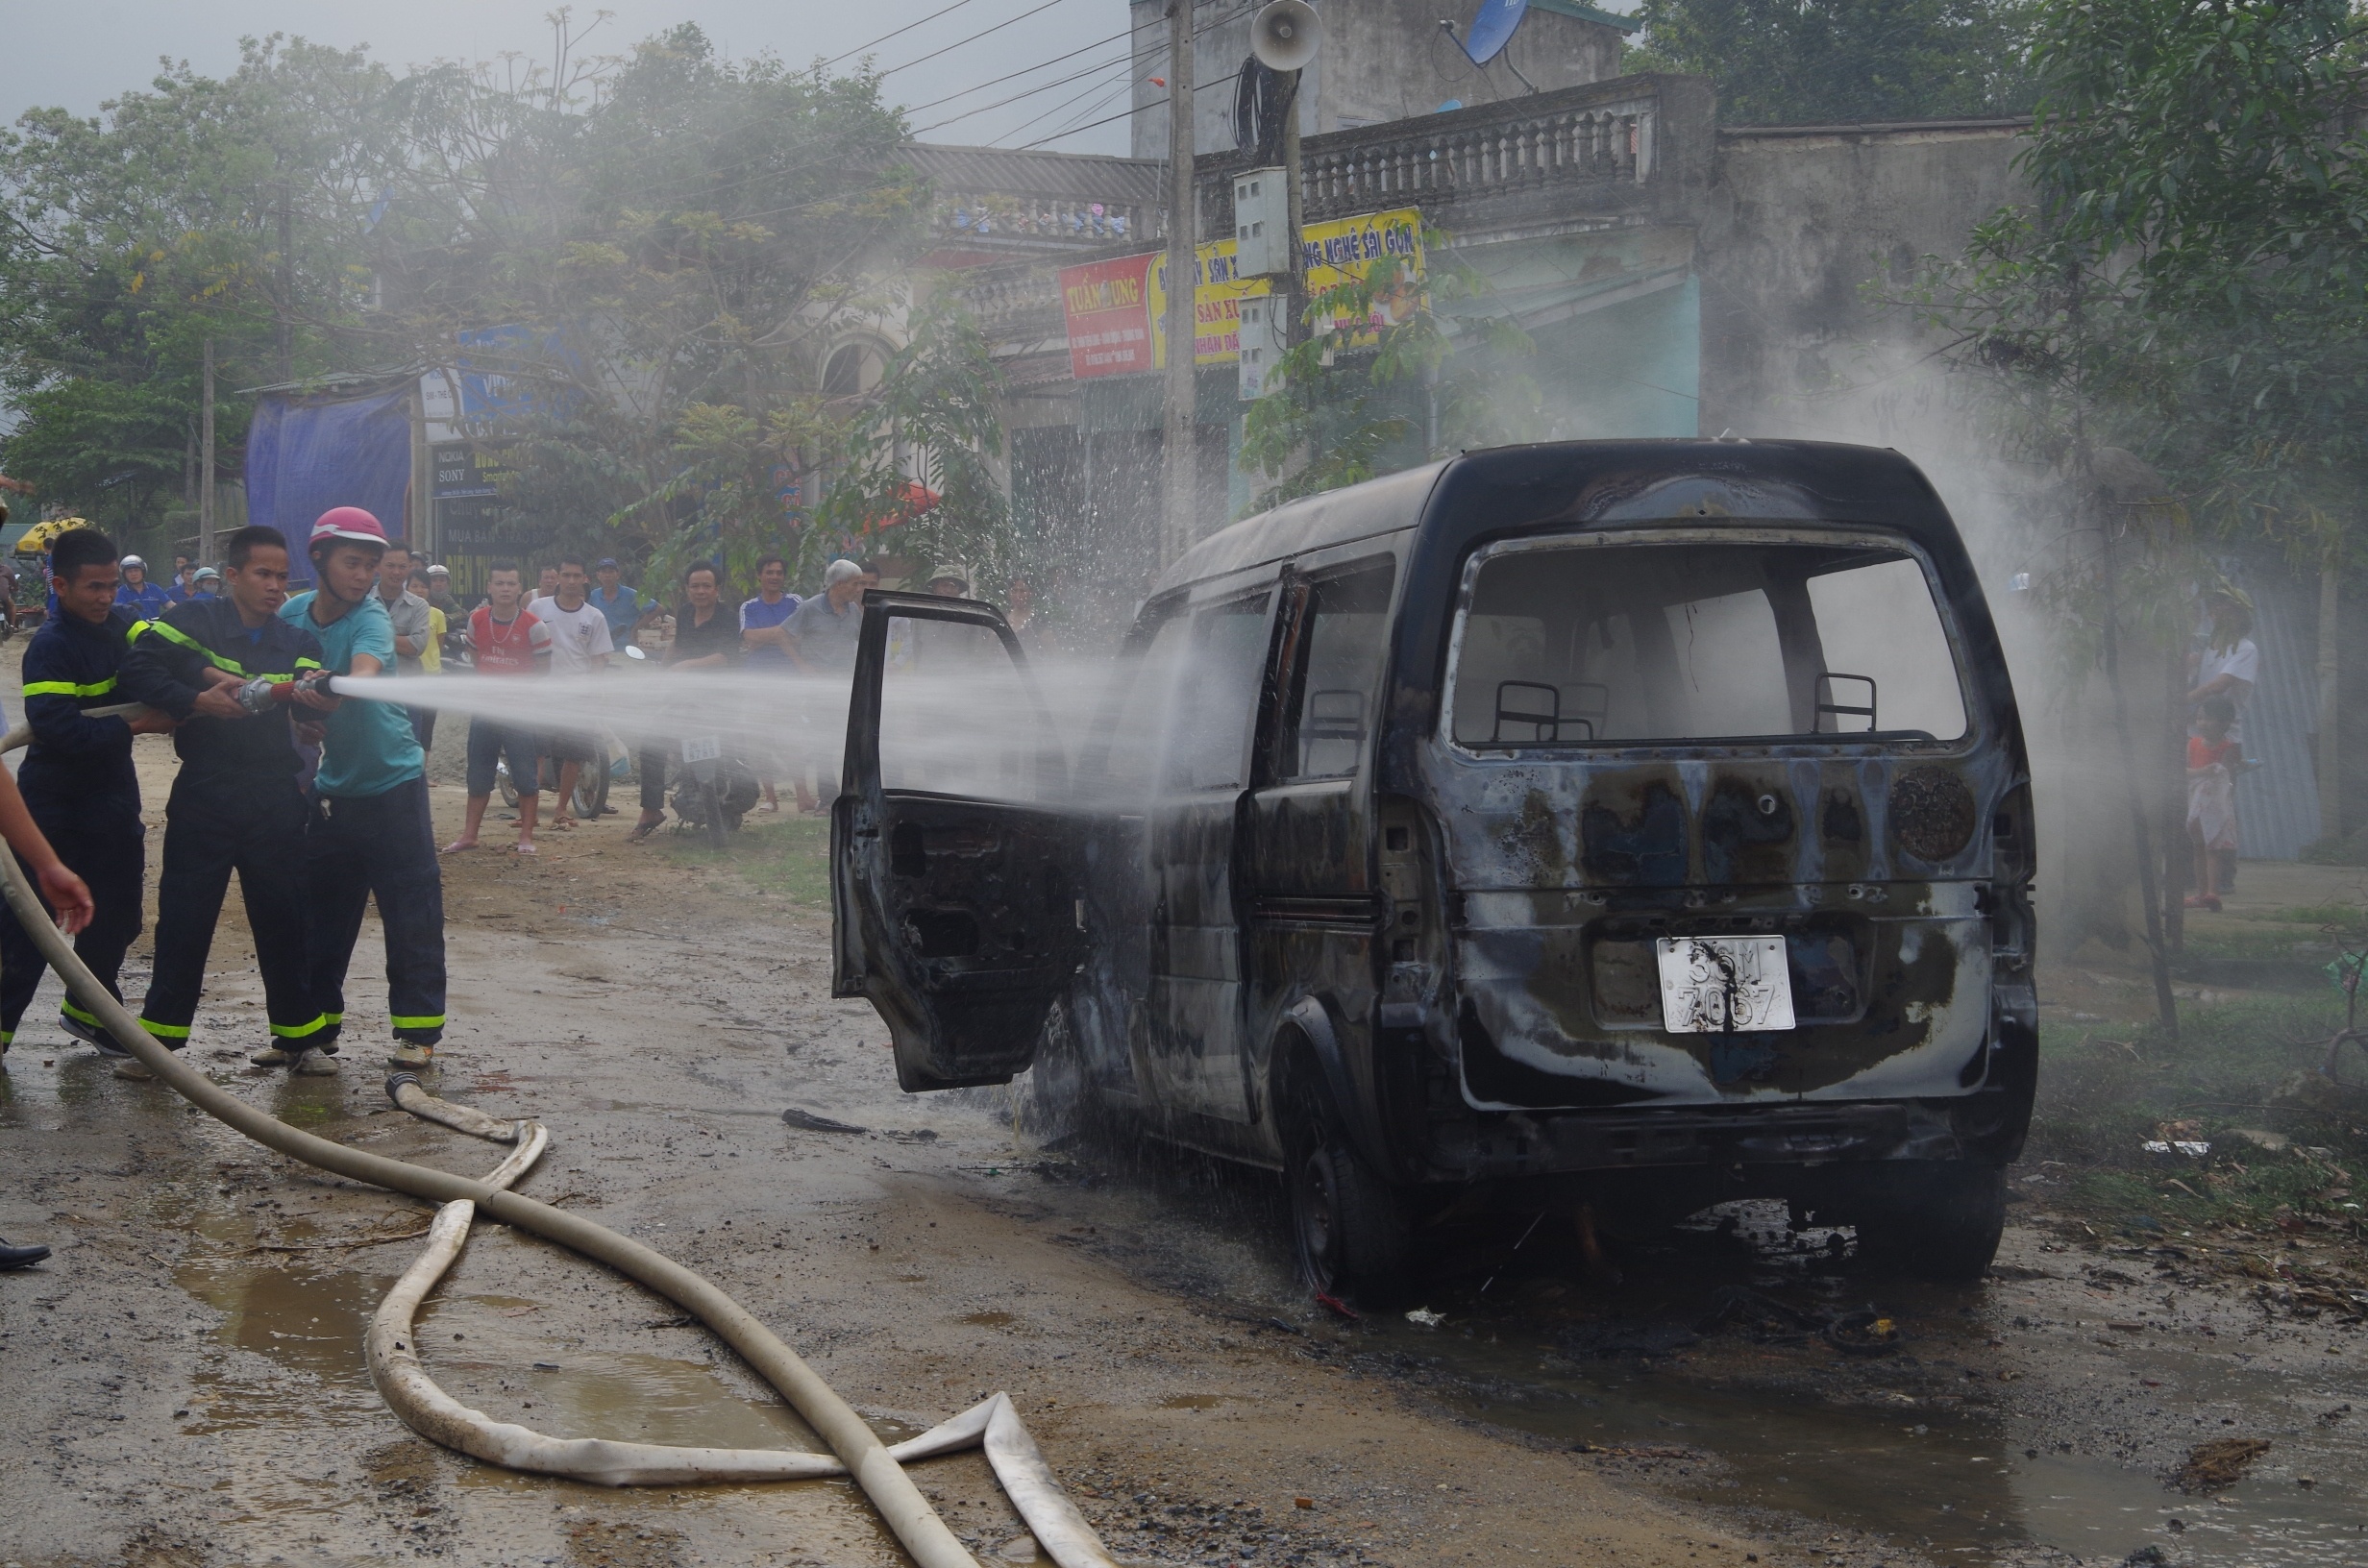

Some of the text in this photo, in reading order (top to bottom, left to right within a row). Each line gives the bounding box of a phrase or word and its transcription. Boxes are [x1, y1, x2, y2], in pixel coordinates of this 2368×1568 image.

[1362, 223, 1382, 259] SÀI
[1106, 277, 1139, 306] UNG
[438, 450, 465, 463] NOKIA
[438, 468, 465, 482] SONY
[448, 528, 472, 543] MUA
[492, 646, 506, 656] Fly
[1677, 984, 1775, 1027] 7067
